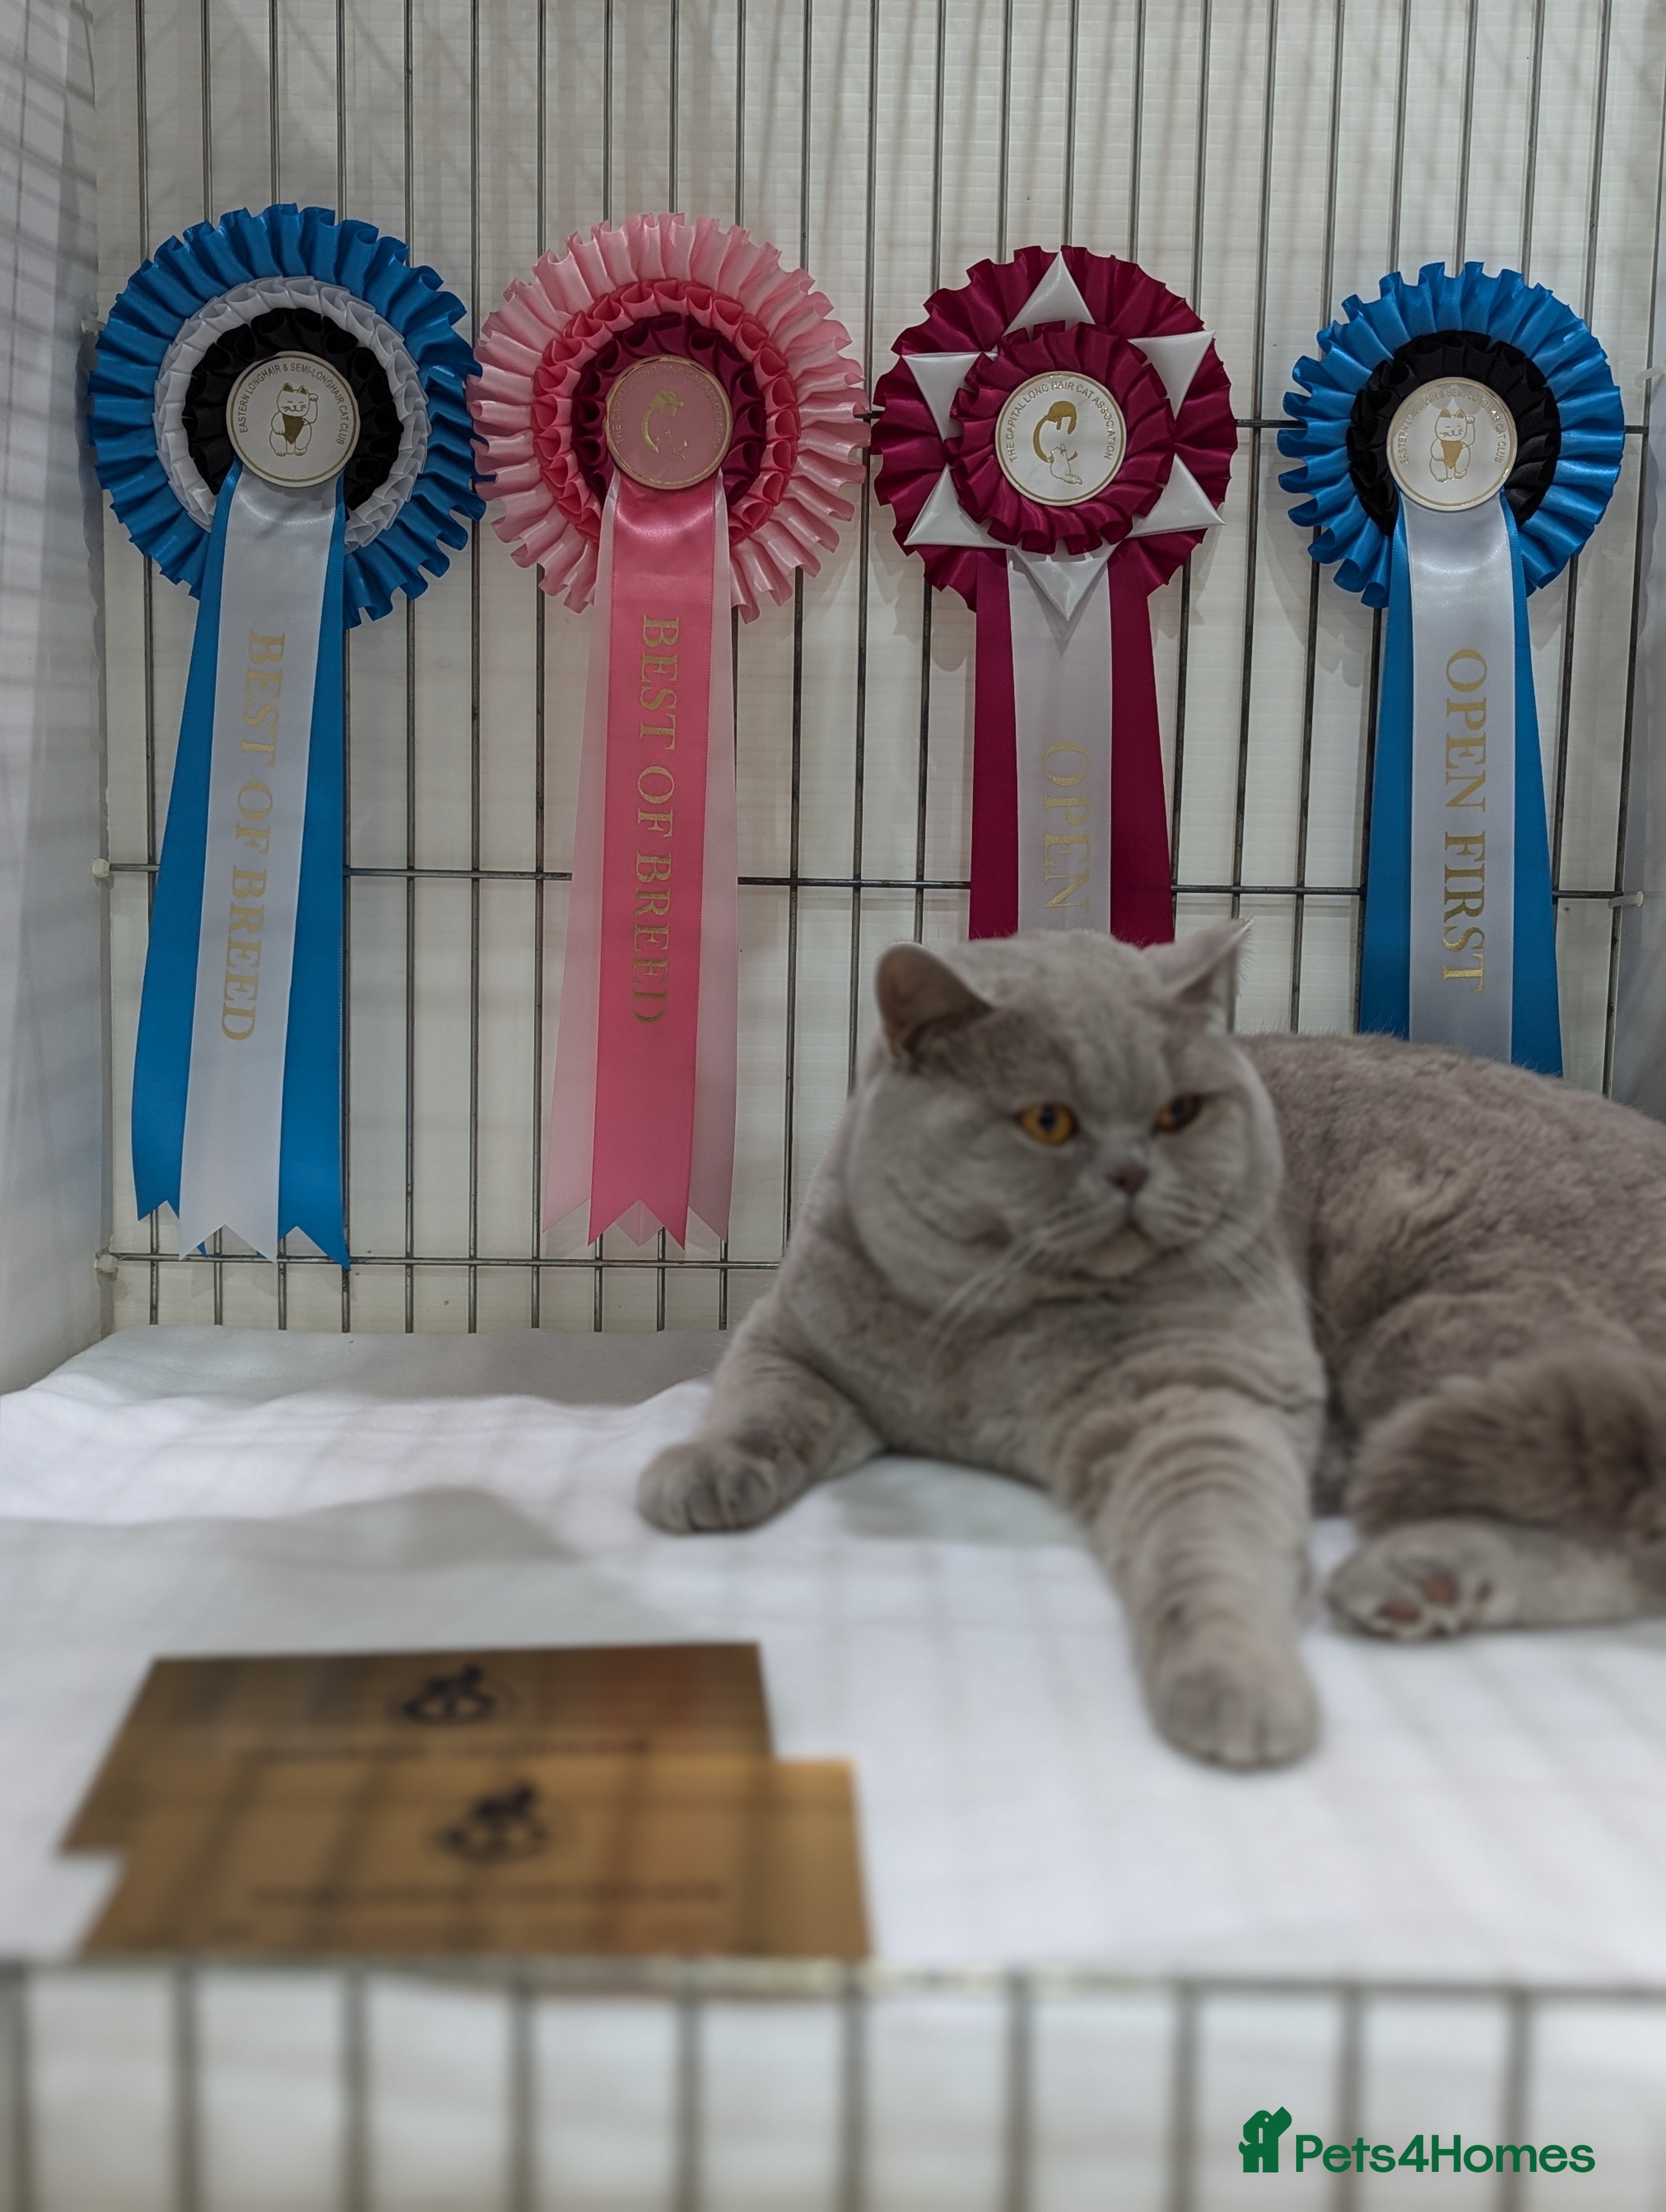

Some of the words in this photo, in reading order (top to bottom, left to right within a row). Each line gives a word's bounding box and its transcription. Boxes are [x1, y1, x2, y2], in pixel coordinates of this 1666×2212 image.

[247, 364, 281, 394] LONGHAIR
[290, 363, 345, 404] SEMI-LONGHAIR
[1023, 383, 1049, 403] LONG
[1051, 381, 1074, 390] HAIR
[1076, 384, 1095, 400] CAT
[238, 394, 250, 433] EASTERN
[336, 422, 349, 445] CLUB
[339, 405, 349, 421] CAT
[1005, 402, 1026, 440] CAPITAL
[1091, 397, 1116, 460] ASSOCIATION
[1006, 442, 1018, 463] THE
[1398, 426, 1410, 465] EASTERN
[241, 631, 286, 768] BEST
[638, 614, 680, 750] BEST
[1445, 648, 1488, 812] OPEN
[234, 781, 274, 856] OF
[637, 765, 675, 838] OF
[1042, 740, 1091, 911] OPEN
[1441, 830, 1486, 994] FIRST
[221, 865, 268, 1041] BREED
[631, 851, 672, 1024] BREED
